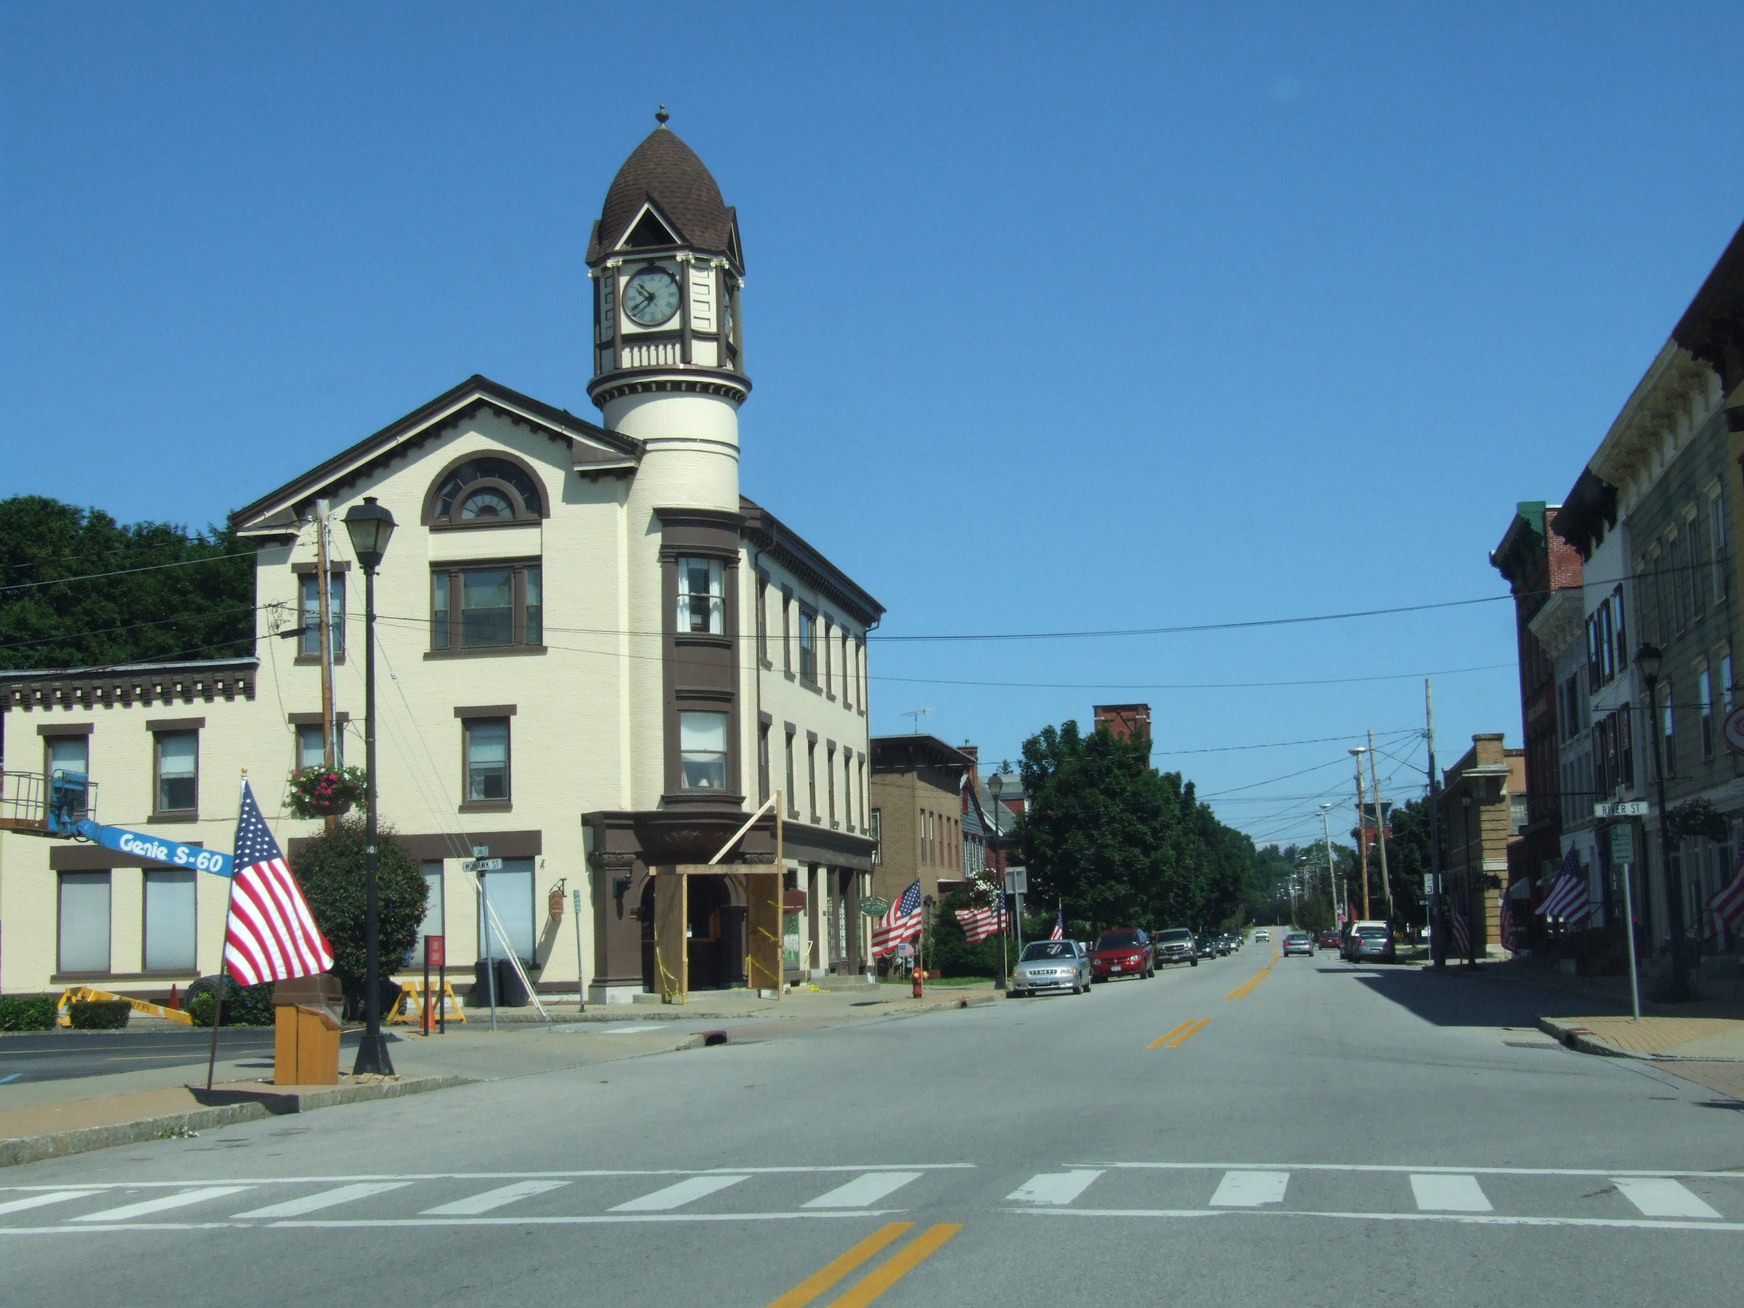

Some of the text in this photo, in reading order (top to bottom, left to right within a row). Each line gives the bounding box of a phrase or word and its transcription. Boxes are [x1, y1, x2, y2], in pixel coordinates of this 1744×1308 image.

[1602, 803, 1640, 815] RIVER ST
[120, 833, 224, 872] Genie S-60
[465, 860, 499, 871] MOHAWK ST
